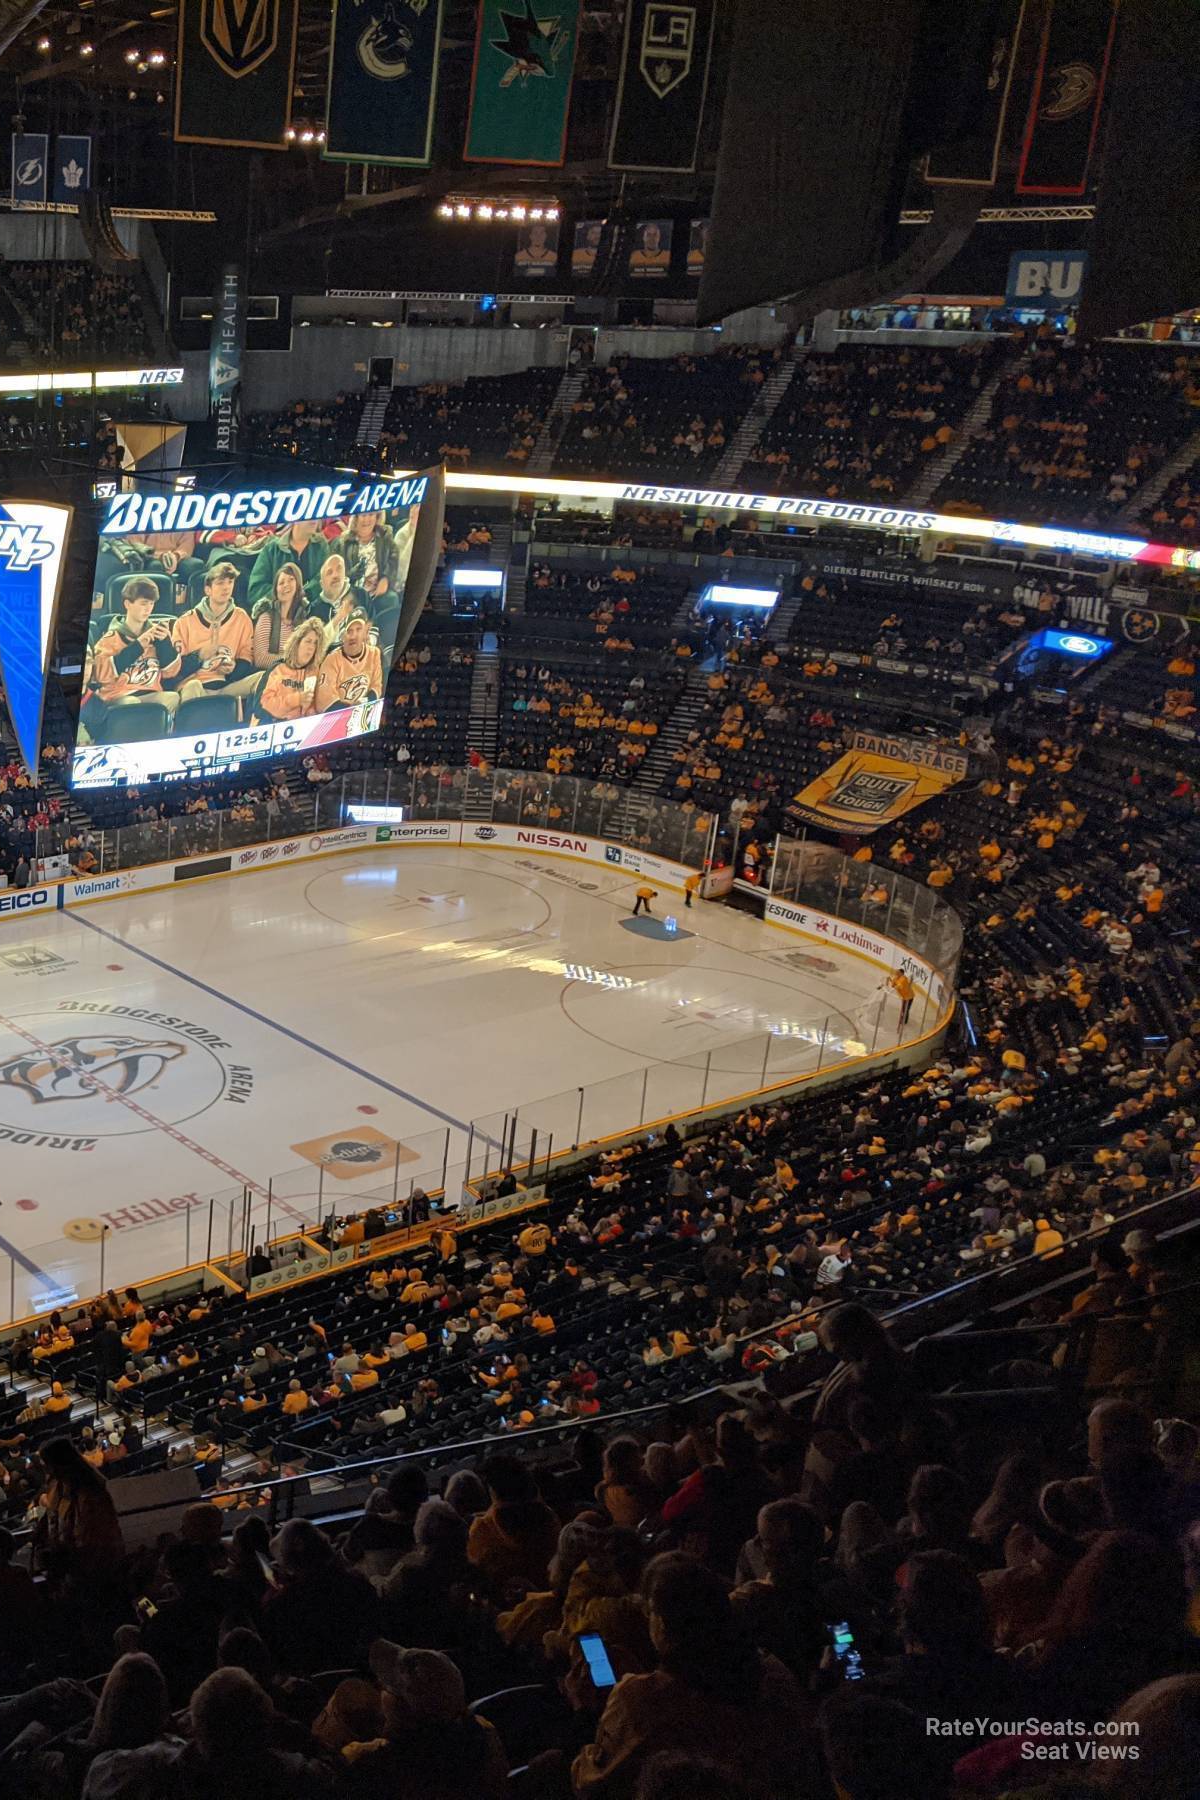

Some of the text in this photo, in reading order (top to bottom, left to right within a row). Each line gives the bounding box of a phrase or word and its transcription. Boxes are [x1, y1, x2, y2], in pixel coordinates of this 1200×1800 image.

[1014, 259, 1085, 299] BU
[222, 274, 238, 353] HEALTH
[102, 483, 352, 534] BRIDGESTONE
[350, 477, 429, 514] ARENA
[622, 485, 939, 529] NASHVILLE PREDATORS
[823, 564, 858, 577] DIERKS
[912, 575, 961, 591] WHISKEY
[194, 725, 295, 755] 0 12:54 0
[856, 735, 965, 773] BAND STAGE
[854, 773, 908, 793] BUILT
[836, 793, 885, 811] TOUGH
[379, 826, 448, 840] enterprise
[517, 831, 588, 853] NISSAN
[74, 878, 121, 897] Walmart
[833, 924, 886, 956] Lochinvar
[901, 956, 929, 985] xfinity
[57, 999, 233, 1051] BRIDGESTONE
[224, 1063, 254, 1104] ARENA
[100, 1192, 205, 1231] Hiller
